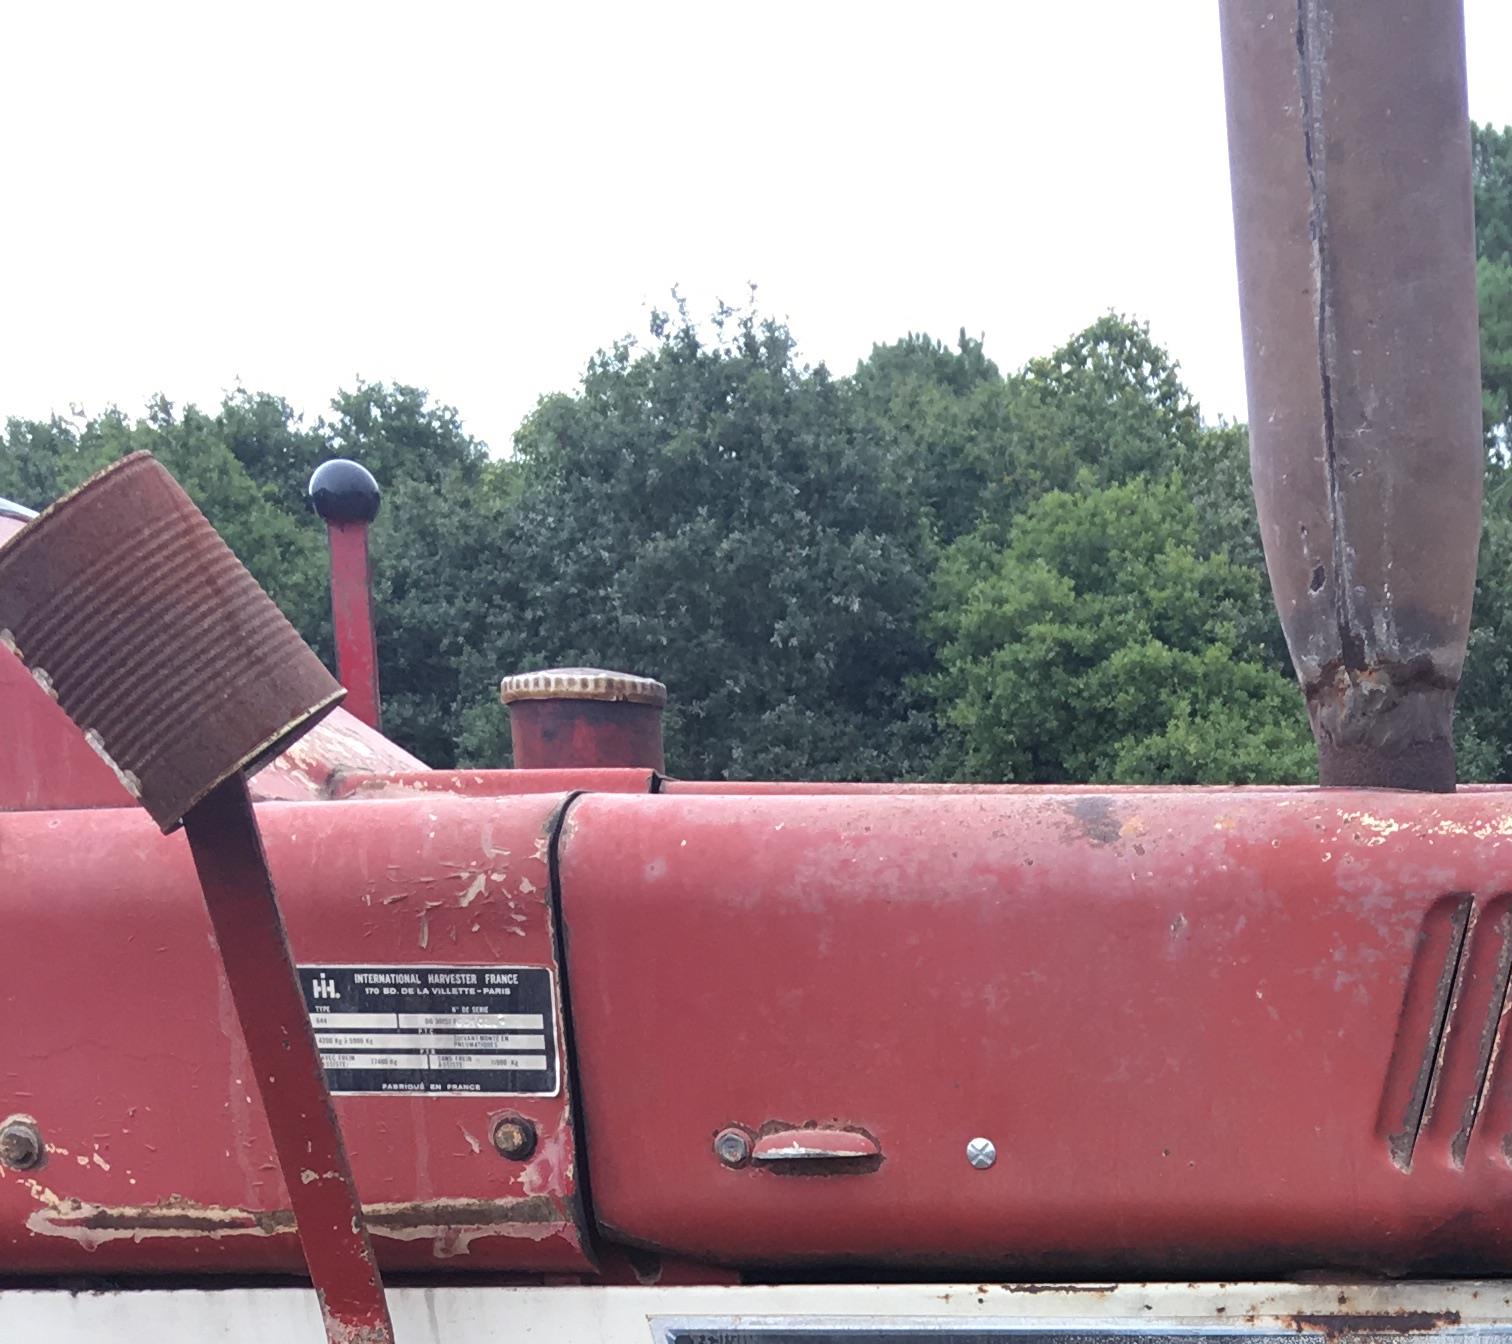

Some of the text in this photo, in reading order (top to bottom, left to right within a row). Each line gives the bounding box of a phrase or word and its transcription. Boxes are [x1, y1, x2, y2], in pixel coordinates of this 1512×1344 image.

[354, 973, 519, 985] INTERNATIONAL HARVESTER FRANCE
[364, 987, 380, 995] 170
[401, 987, 415, 995] DE
[416, 987, 430, 995] LA
[315, 1005, 331, 1013] TYPE
[446, 1083, 481, 1091] FRANCE
